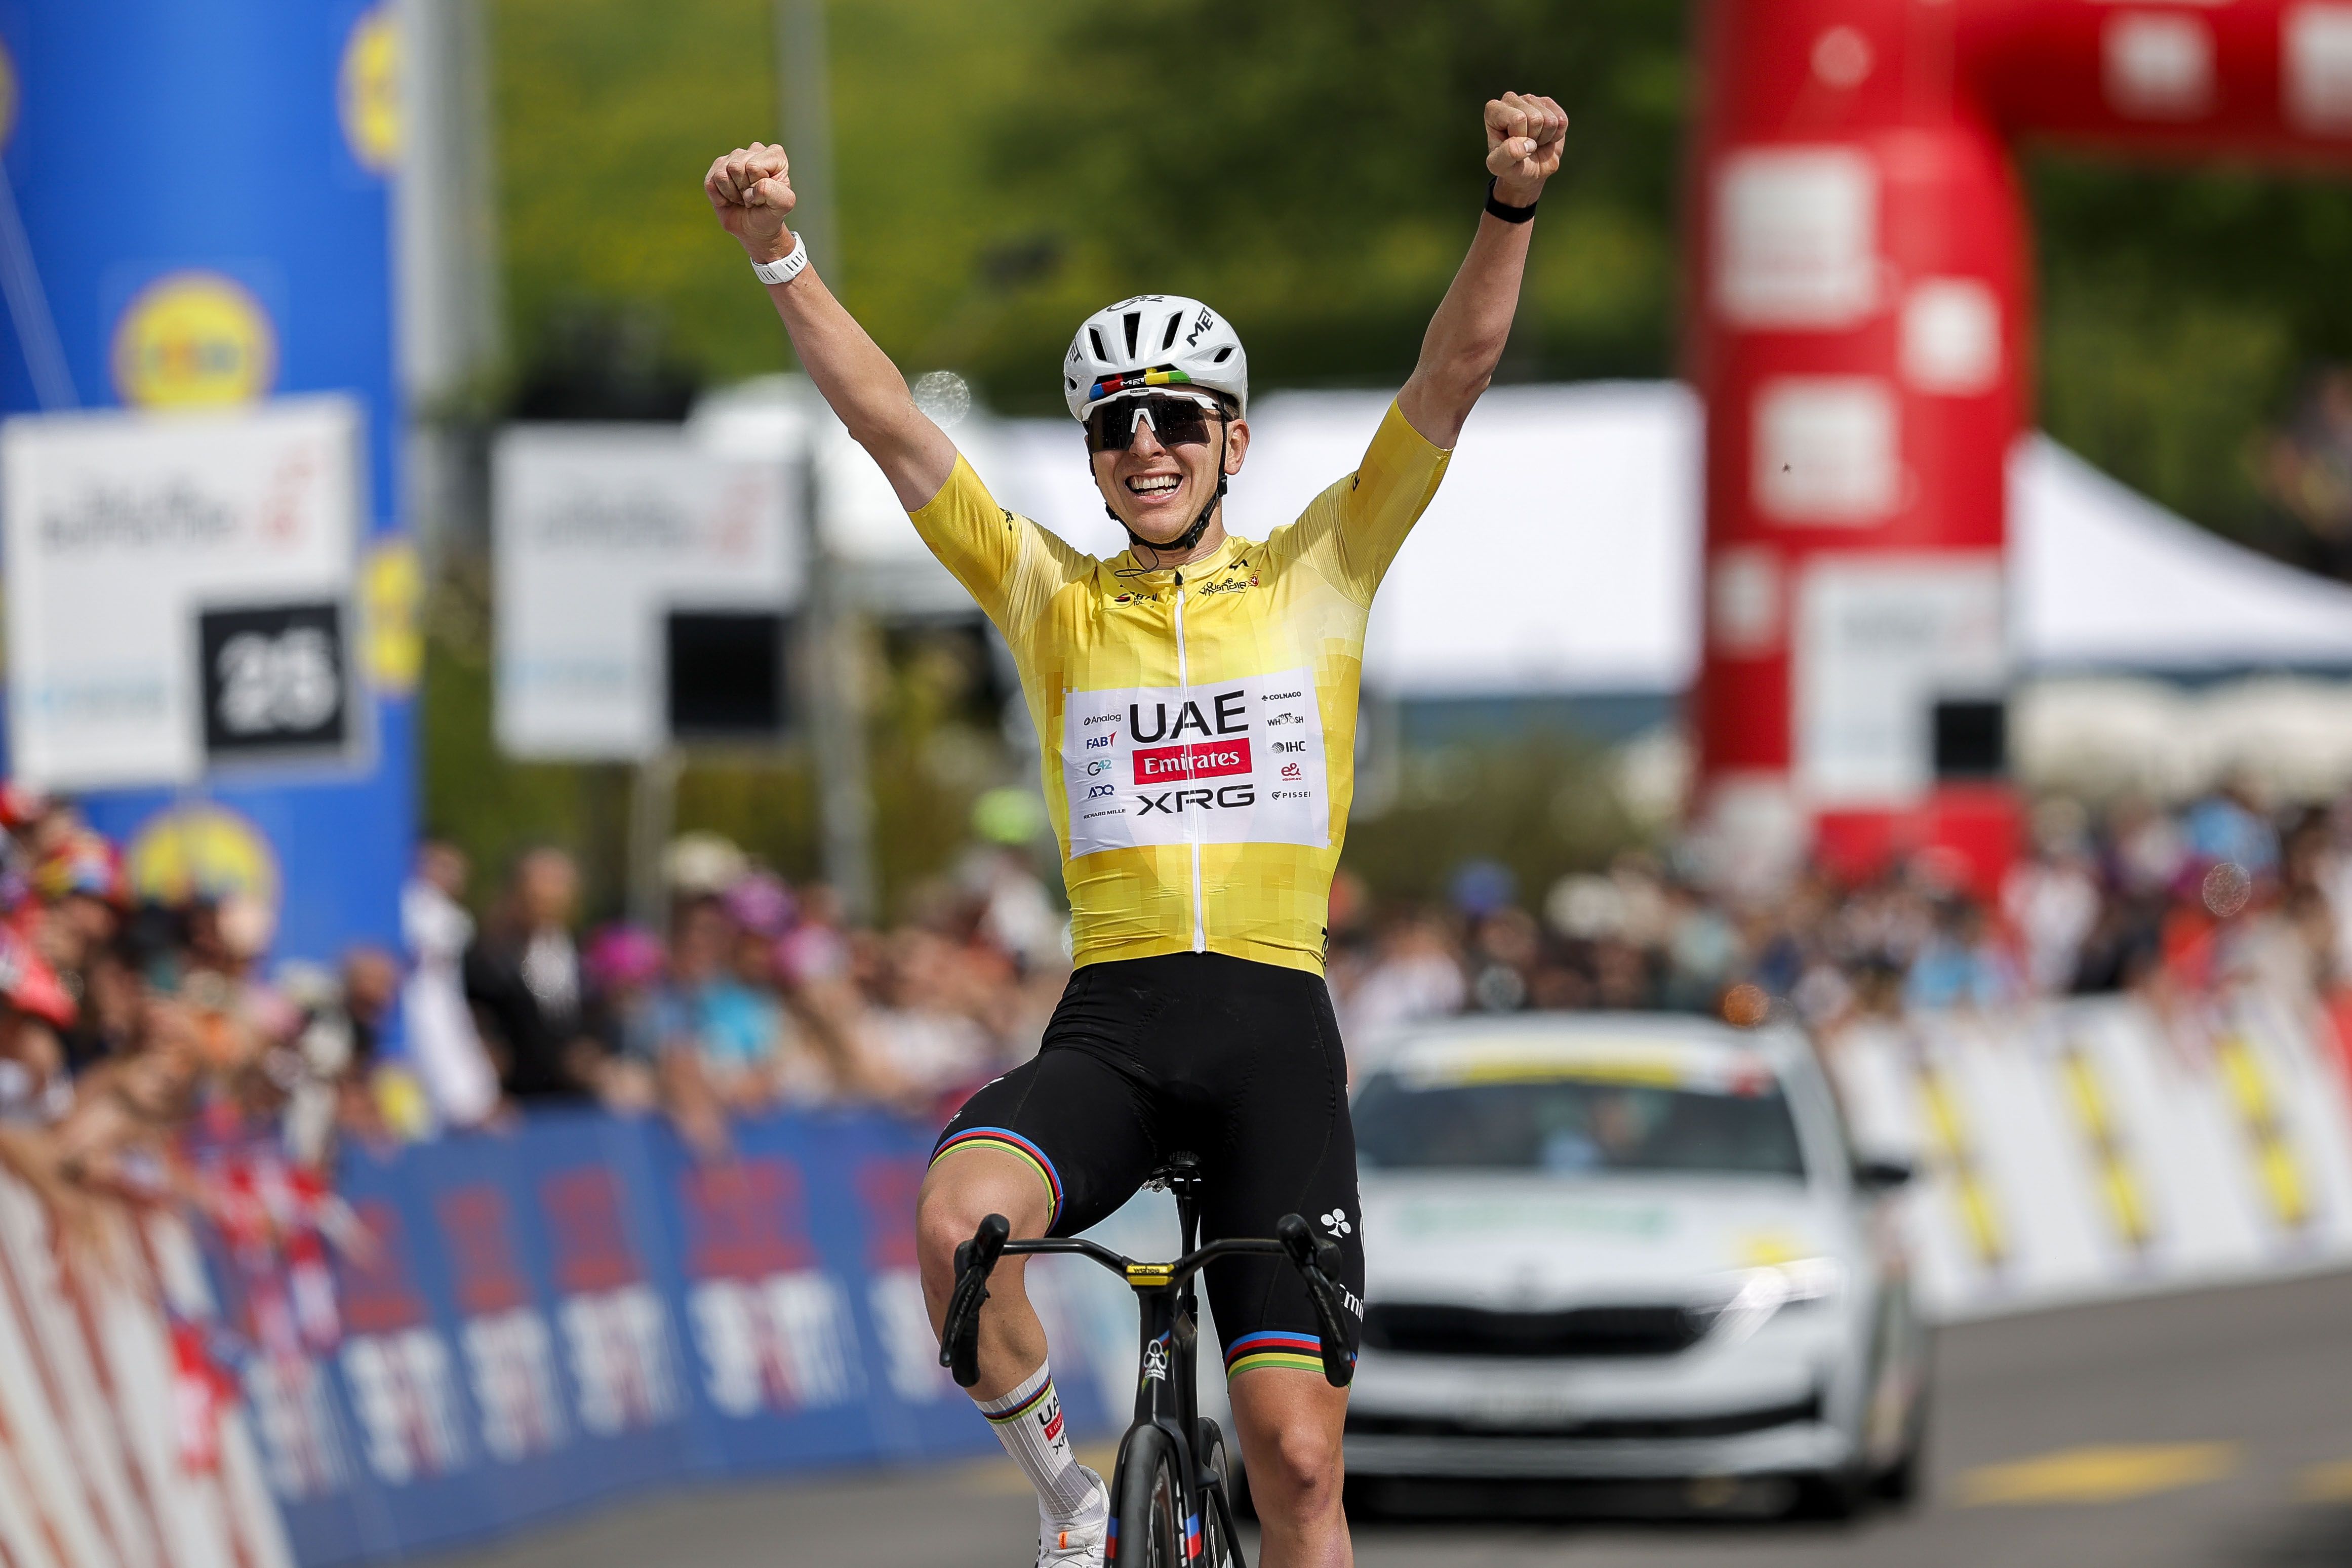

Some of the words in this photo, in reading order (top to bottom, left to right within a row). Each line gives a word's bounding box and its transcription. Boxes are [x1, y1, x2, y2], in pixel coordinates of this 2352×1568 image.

[1186, 306, 1214, 348] MET
[1120, 377, 1147, 386] MET
[1269, 691, 1302, 700] COLNAGO
[1091, 713, 1121, 724] Analog
[1130, 690, 1249, 743] UAE
[1286, 741, 1306, 752] IHC
[1087, 759, 1112, 776] G42
[1144, 751, 1240, 775] Emirates
[1087, 784, 1114, 799] ADQ
[1136, 784, 1255, 816] XRG
[1083, 811, 1106, 820] RICHARD
